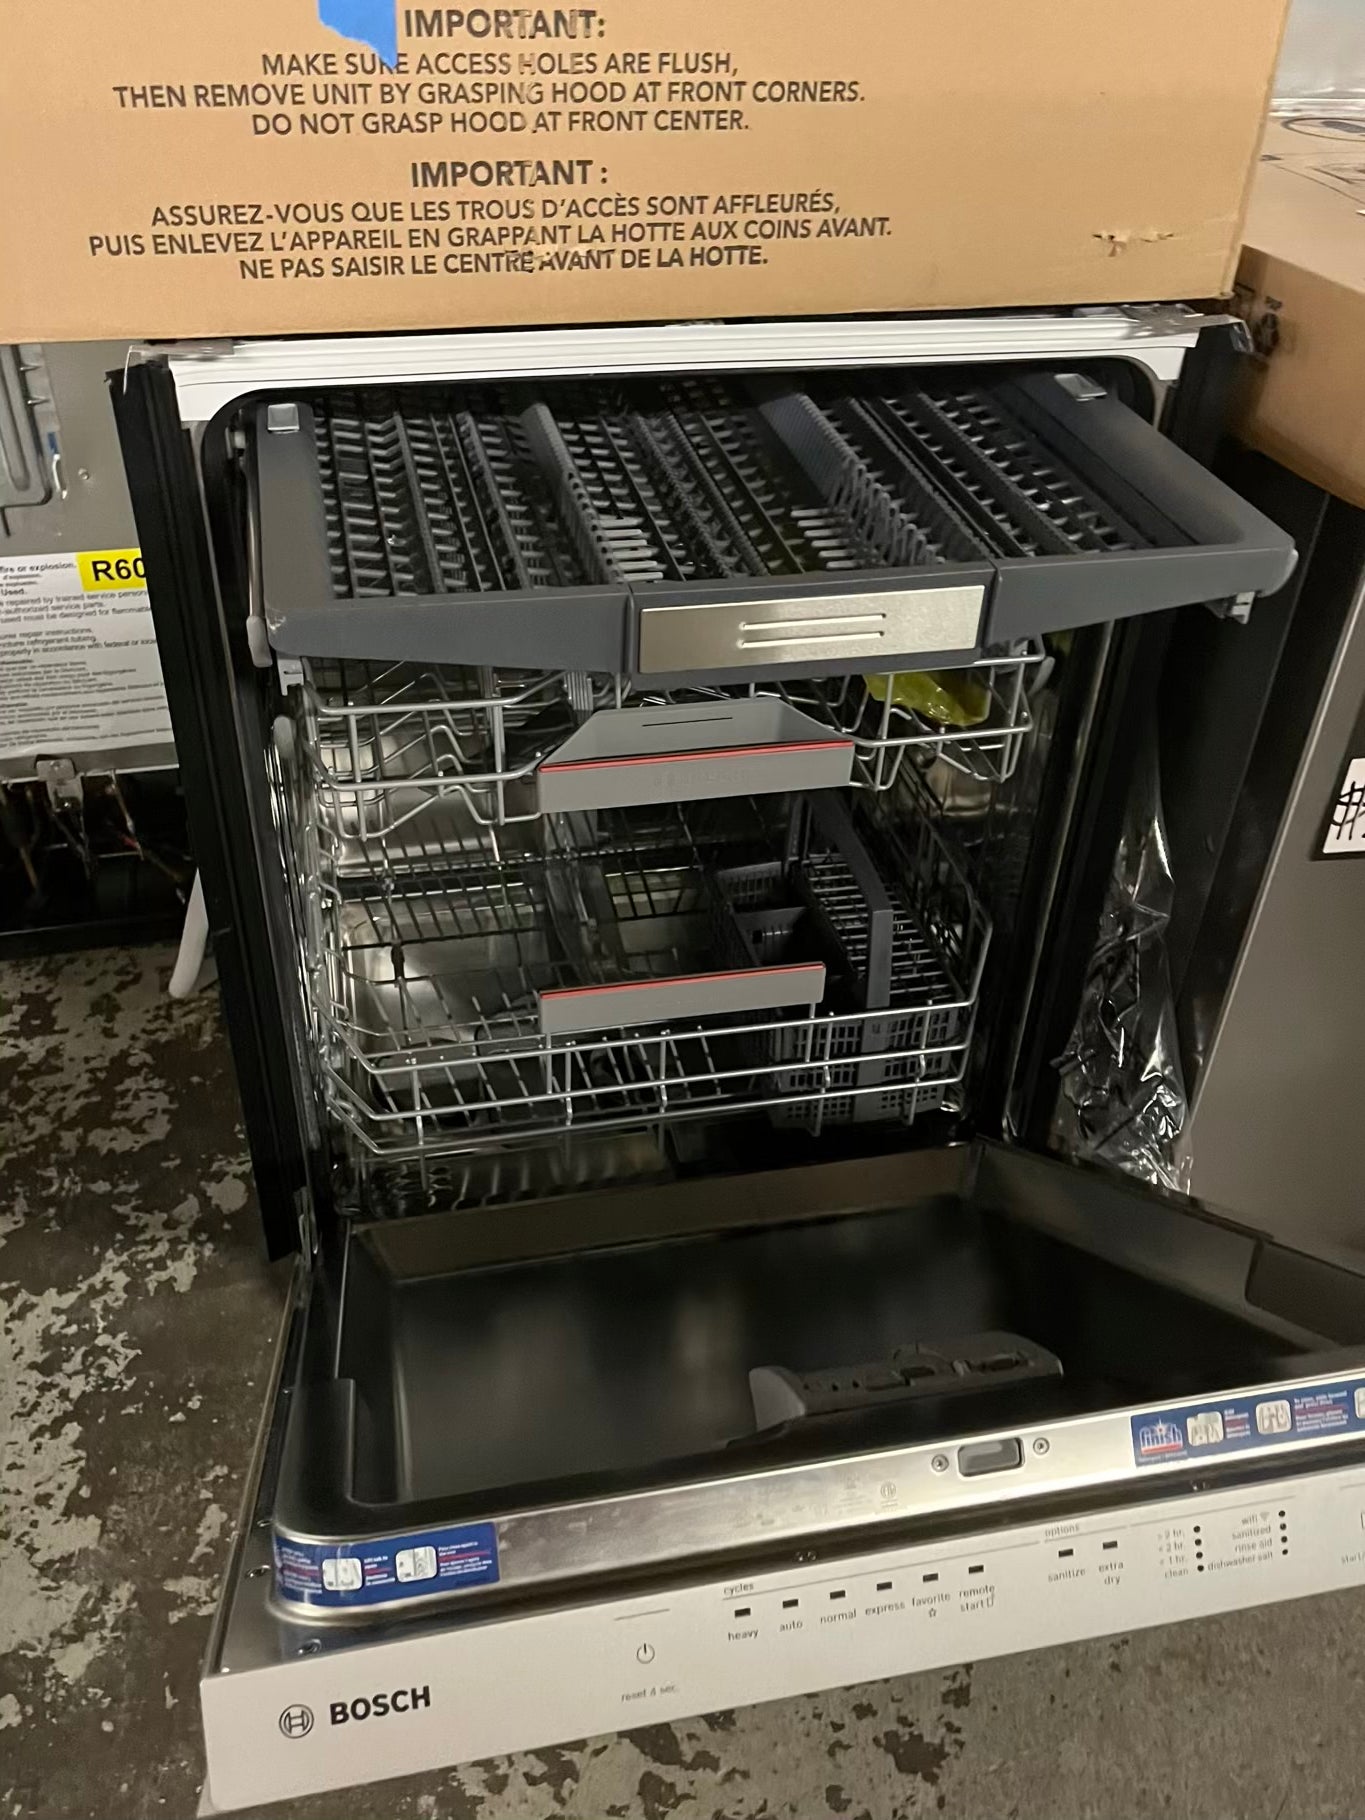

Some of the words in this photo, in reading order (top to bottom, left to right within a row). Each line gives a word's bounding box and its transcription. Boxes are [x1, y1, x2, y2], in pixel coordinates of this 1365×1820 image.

[405, 9, 605, 39] IMPORTANT:
[262, 53, 338, 76] MAKE
[416, 52, 511, 75] ACCESS
[518, 52, 597, 75] HOLES
[604, 53, 651, 74] ARE
[659, 52, 738, 76] FLUSH,
[112, 85, 186, 108] THEN
[193, 83, 305, 107] REMOVE
[313, 83, 372, 105] UNIT
[380, 83, 411, 104] BY
[418, 82, 544, 104] GRASPING
[552, 81, 626, 103] HOOD
[632, 81, 662, 102] AT
[668, 81, 747, 102] FRONT
[753, 81, 865, 102] CORNERS.
[252, 113, 292, 135] DO
[300, 113, 355, 134] NOT
[362, 112, 443, 134] GRASP
[451, 111, 527, 132] HOOD
[533, 111, 562, 133] AT
[568, 111, 648, 131] FRONT
[654, 110, 749, 131] CENTER.
[412, 160, 593, 188] IMPORTANT
[152, 203, 344, 226] ASSUREZ-VOUS
[351, 202, 404, 222] QUE
[411, 201, 450, 221] LES
[456, 199, 535, 220] TROUS
[646, 196, 709, 216] SONT
[713, 190, 840, 214] AFFLEURÉS,
[89, 234, 145, 256] PUIS
[152, 232, 264, 254] ENLEVEZ
[408, 228, 440, 248] EN
[448, 225, 572, 247] GRAPPANT
[578, 224, 605, 243] LA
[612, 222, 685, 242] HOTTE
[690, 221, 738, 240] AUX
[744, 219, 811, 239] COINS
[816, 217, 891, 237] AVANT.
[240, 259, 274, 279] NE
[281, 258, 324, 278] PAS
[331, 256, 405, 277] SAISIR
[411, 255, 437, 274] LE
[444, 250, 534, 274] CENTRE
[538, 249, 616, 271] AVANT
[621, 248, 651, 268] DE
[657, 248, 684, 267] LA
[690, 245, 768, 266] HOTTE.
[1045, 1523, 1079, 1537] options
[1232, 1525, 1271, 1540] sanitized
[1260, 1537, 1272, 1549] aid
[1099, 1561, 1123, 1573] extra
[1165, 1568, 1188, 1579] clean
[1048, 1568, 1085, 1583] sanitize
[1104, 1575, 1120, 1586] dry
[723, 1583, 754, 1596] cycles
[959, 1584, 995, 1599] remote
[912, 1592, 951, 1608] favorite
[960, 1600, 984, 1613] start
[865, 1601, 905, 1616] express
[820, 1609, 857, 1624] normal
[780, 1619, 803, 1632] auto
[728, 1628, 759, 1641] heavy
[621, 1688, 646, 1702] reset
[329, 1685, 431, 1725] BOSCH
